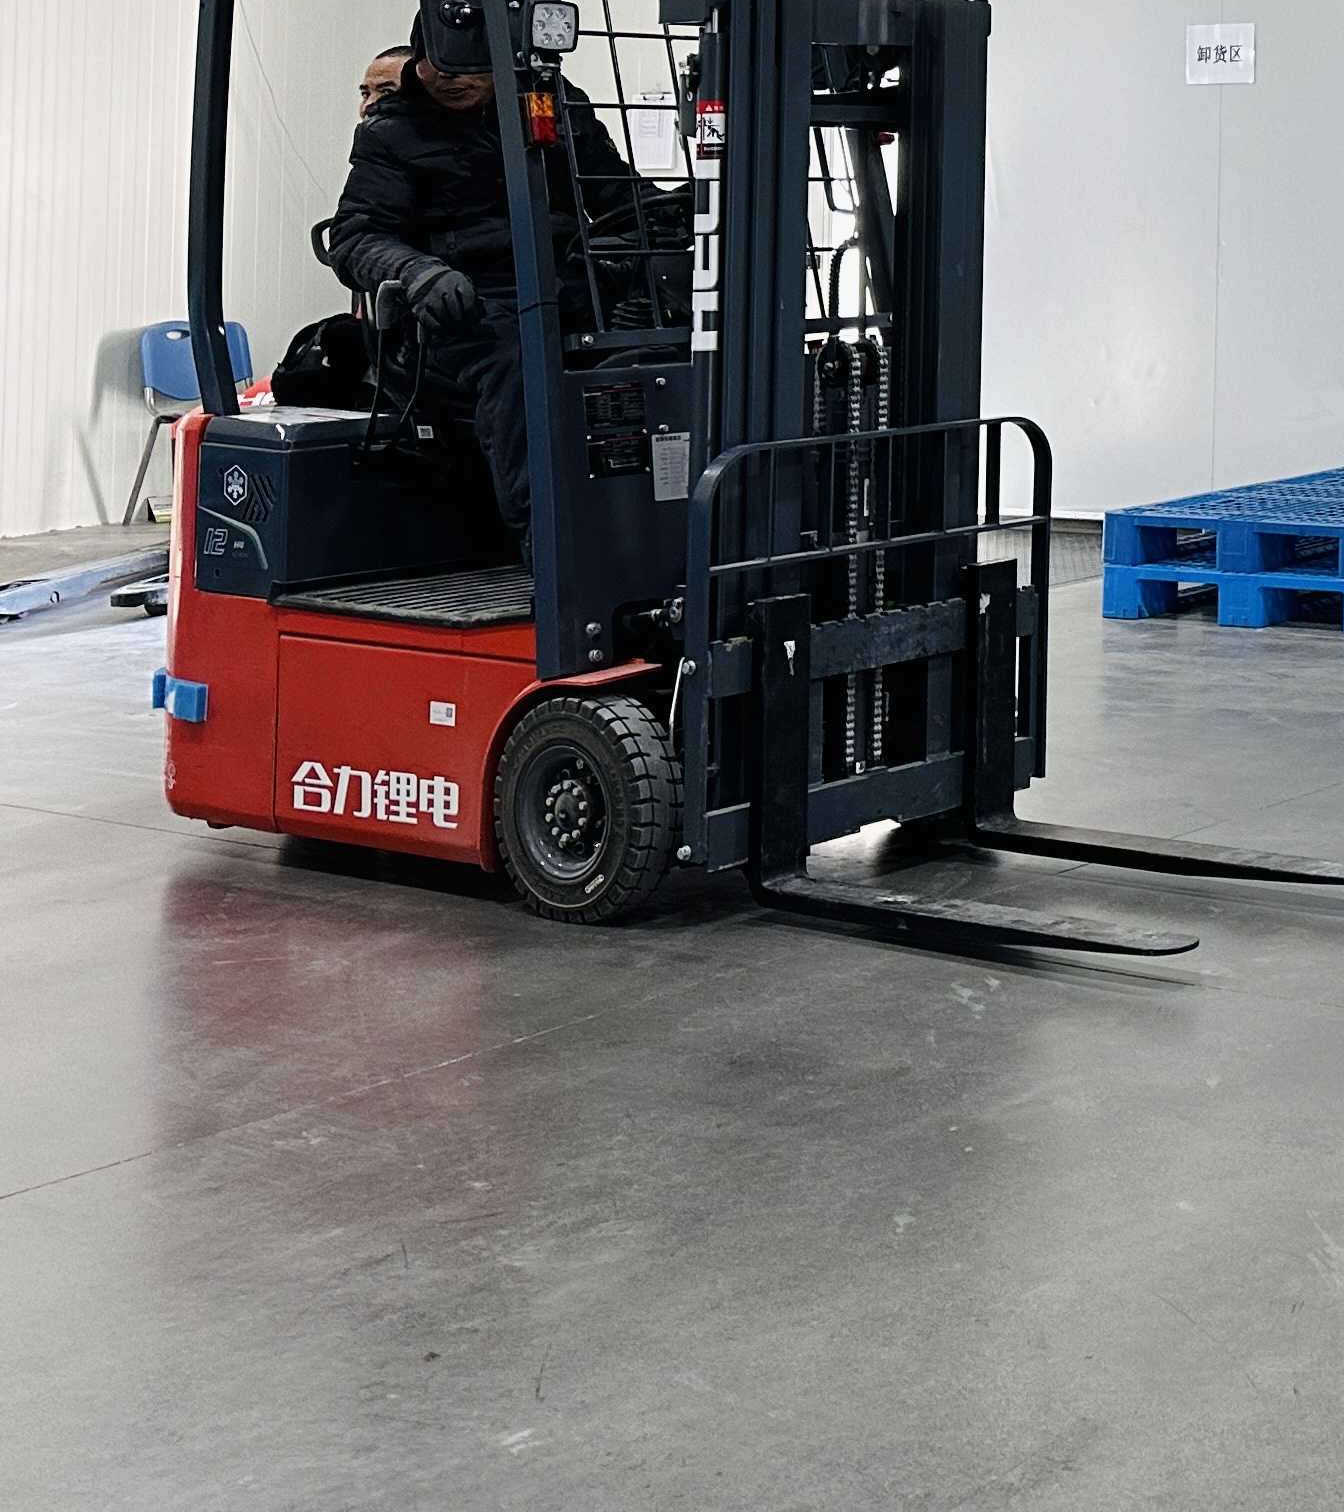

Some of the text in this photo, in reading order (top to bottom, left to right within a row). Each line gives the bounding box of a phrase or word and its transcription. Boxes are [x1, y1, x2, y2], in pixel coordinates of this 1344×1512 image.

[1197, 44, 1243, 64] 卸货区
[291, 761, 460, 829] 合力锂电
